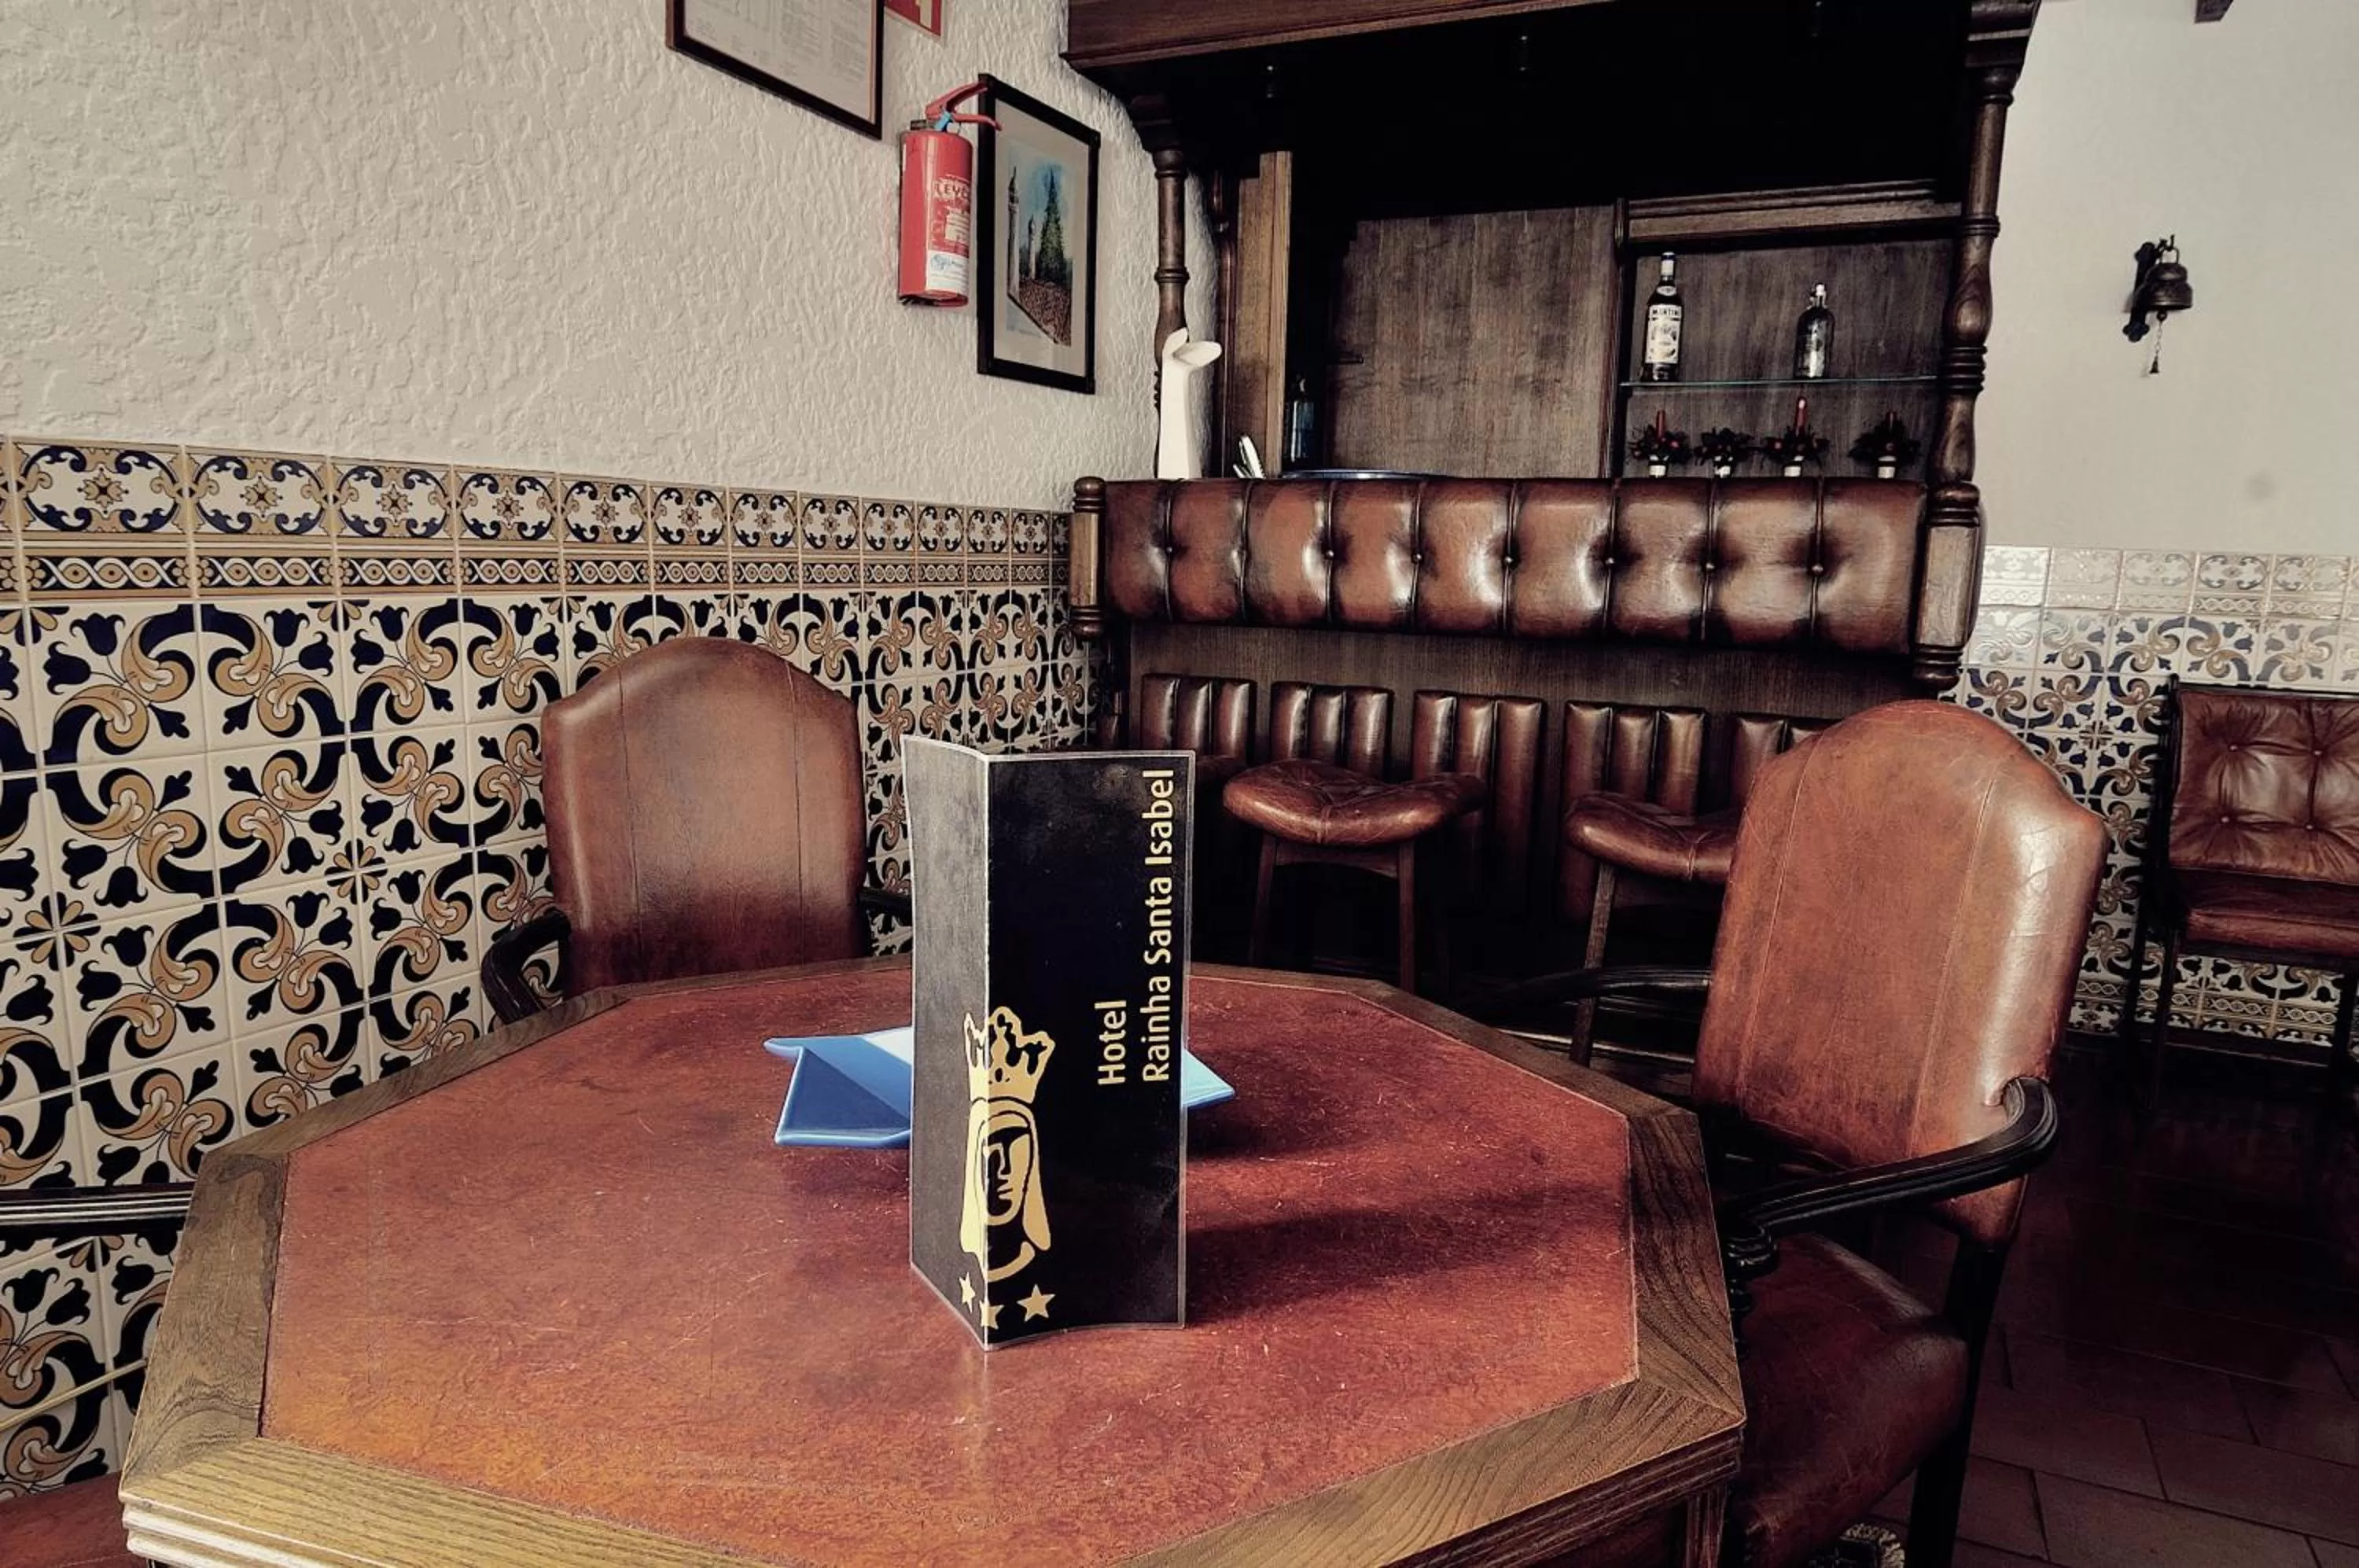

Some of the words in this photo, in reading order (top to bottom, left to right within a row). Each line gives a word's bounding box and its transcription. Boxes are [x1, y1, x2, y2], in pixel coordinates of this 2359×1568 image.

[1142, 770, 1174, 865] Isabel
[1143, 877, 1172, 966] Santa
[1094, 1000, 1127, 1085] Hotel
[1139, 976, 1171, 1081] Rainha
